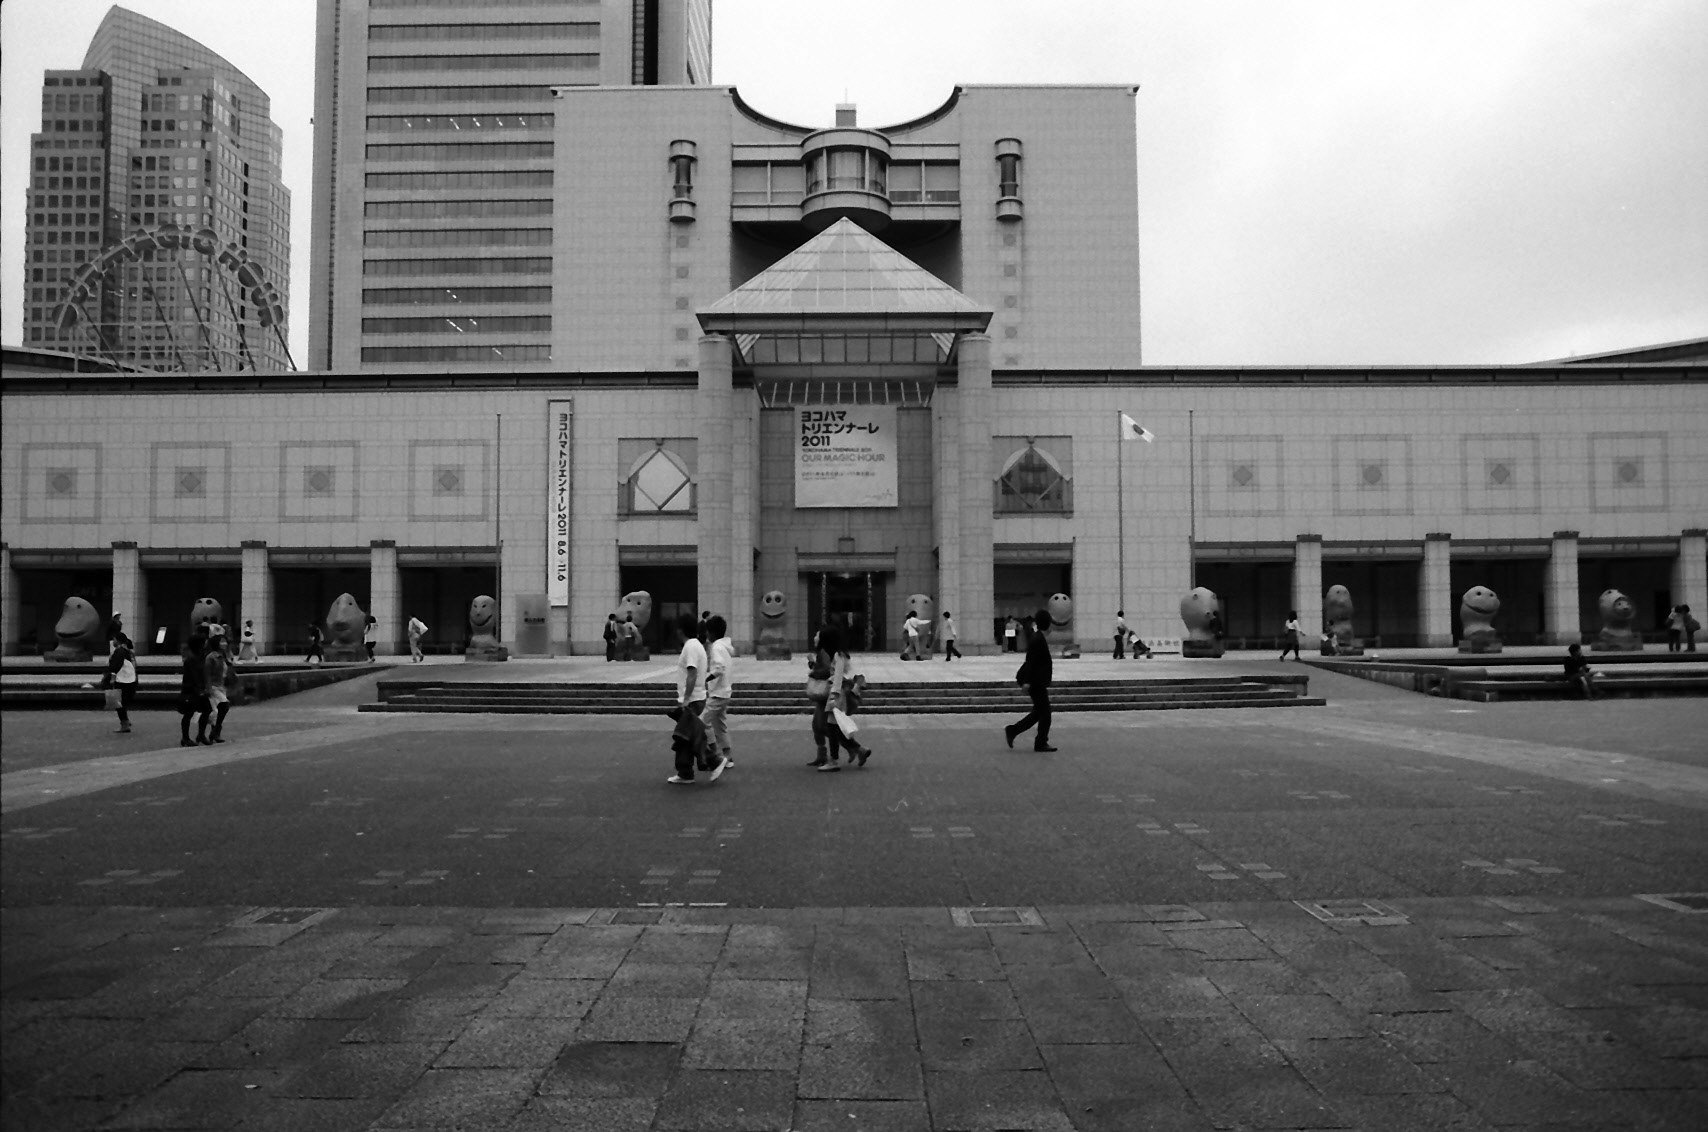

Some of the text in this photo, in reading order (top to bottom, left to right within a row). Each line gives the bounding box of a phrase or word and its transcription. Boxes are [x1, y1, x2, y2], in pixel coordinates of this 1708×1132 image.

[218, 242, 284, 328] HOUR
[801, 410, 847, 422] ヨコハマ
[801, 422, 880, 434] トリエンナーレ
[801, 435, 831, 447] 2011
[801, 453, 886, 463] OUR MAGIC HOUR
